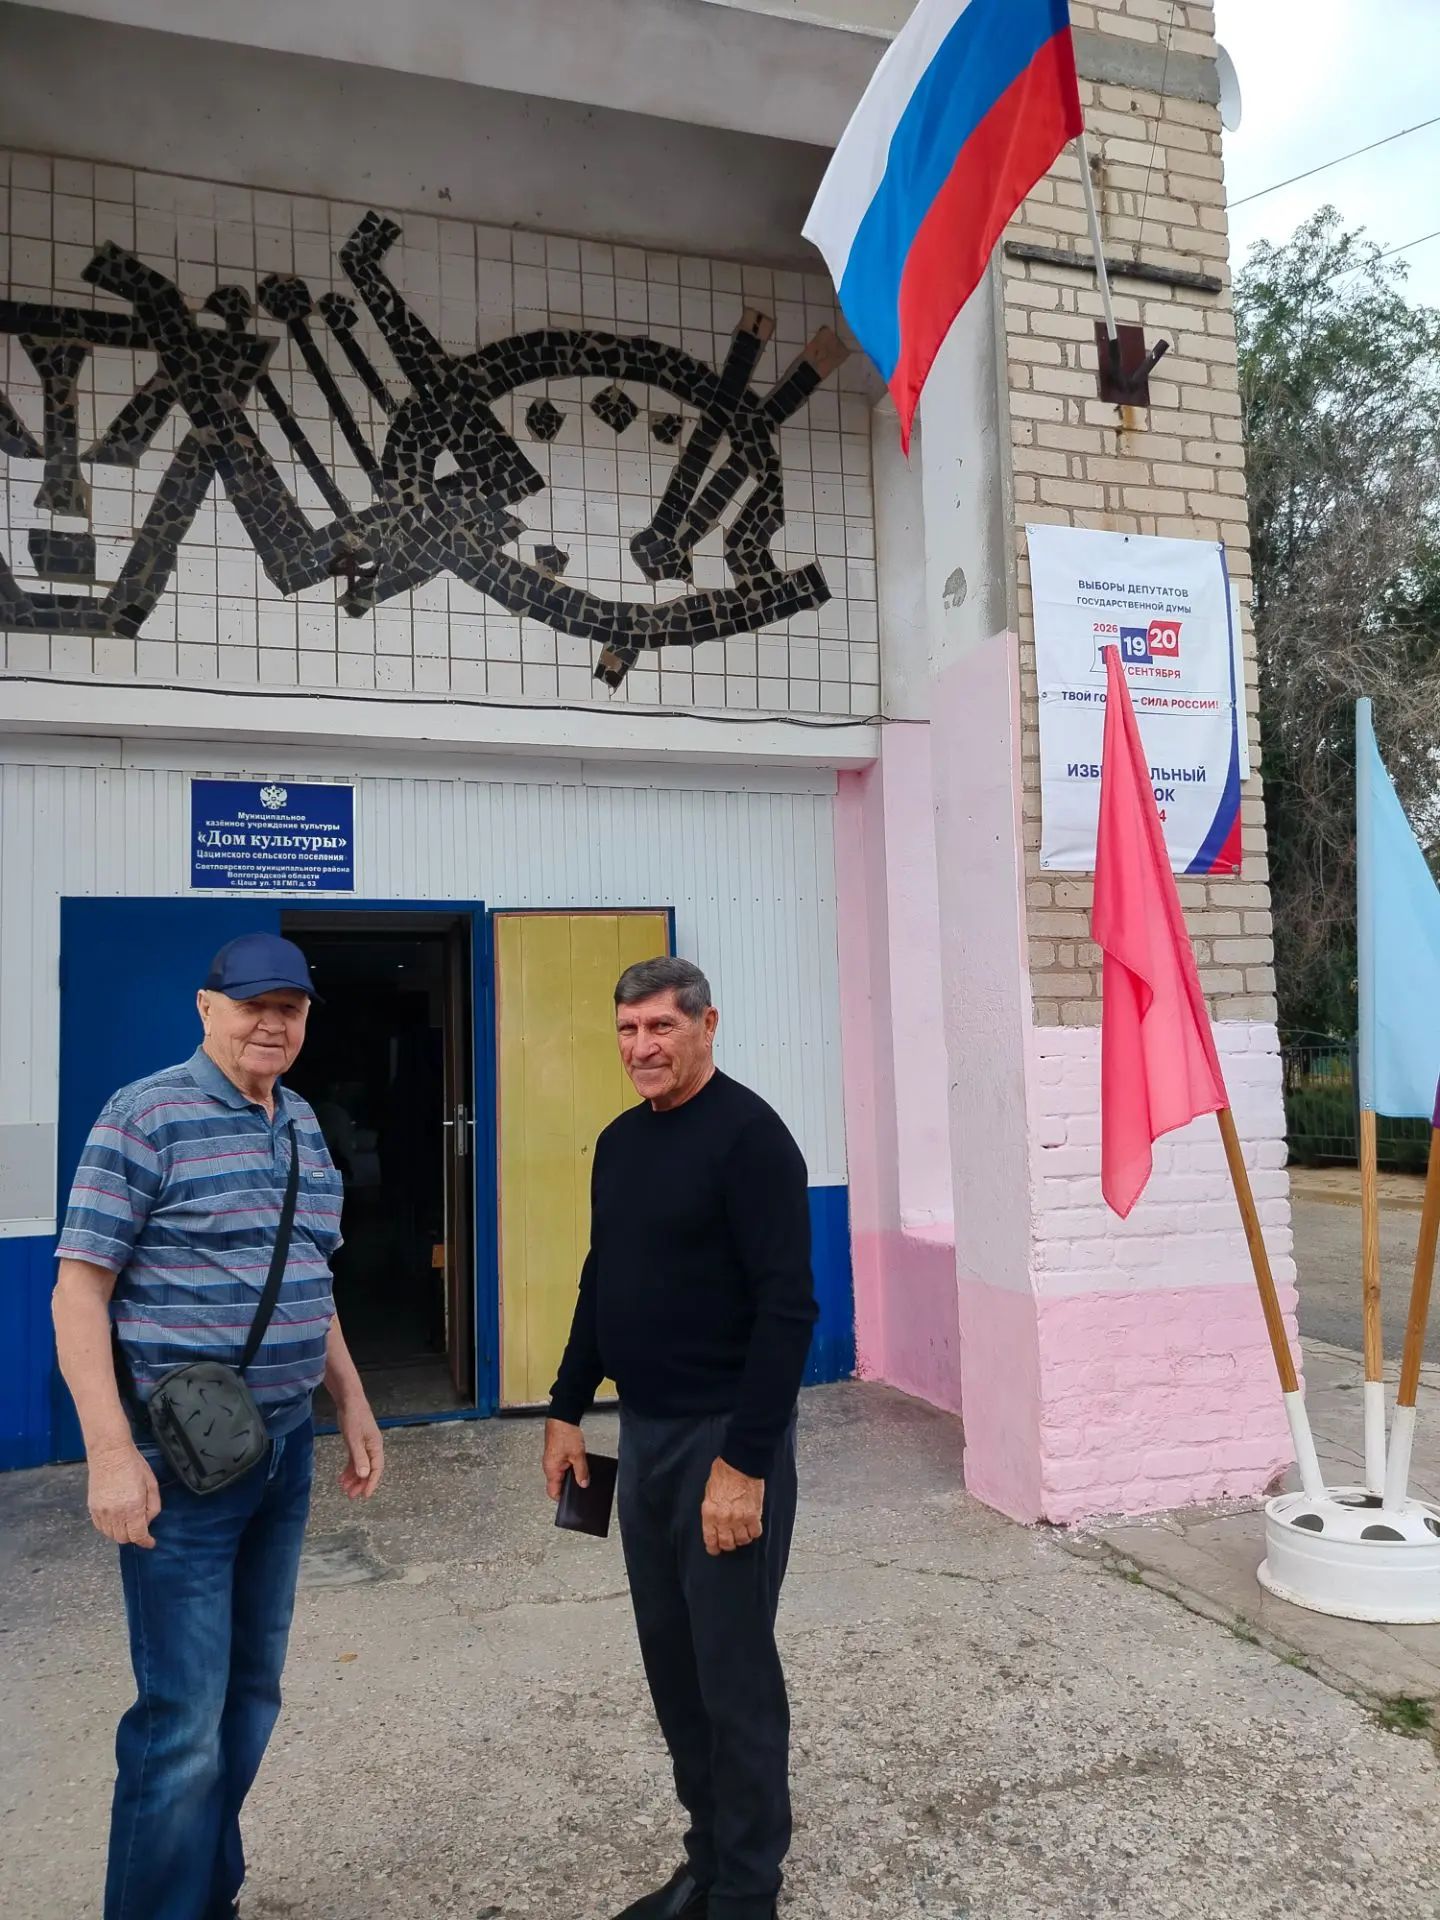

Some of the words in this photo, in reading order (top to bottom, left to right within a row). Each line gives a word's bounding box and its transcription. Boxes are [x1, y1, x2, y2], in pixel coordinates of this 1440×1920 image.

[1078, 580, 1125, 592] ВЫБОРЫ
[1128, 584, 1189, 598] ДЕПУТАТОВ
[1077, 596, 1164, 611] ГОСУДАРСТВЕННОЙ
[1166, 605, 1191, 614] ДУМЫ
[1093, 623, 1118, 633] 2026
[1123, 636, 1146, 657] 19
[1149, 628, 1177, 649] 20
[1127, 666, 1181, 679] СЕНТЯБРЯ
[1062, 691, 1091, 702] ТВОЙ
[1141, 697, 1168, 707] СИЛА
[1171, 699, 1219, 709] РОССИИ!
[238, 812, 306, 822] Муниципальное
[205, 819, 245, 827] казённое
[247, 821, 298, 829] учреждение
[300, 822, 340, 831] культуры
[197, 830, 246, 847] «Дом
[250, 835, 347, 851] культуры»
[197, 850, 251, 859] Цацинского
[252, 852, 297, 860] сельского
[298, 853, 344, 861] поселения
[195, 863, 255, 871] Светлоярского
[227, 871, 286, 879] Волгоградской
[287, 872, 320, 880] области
